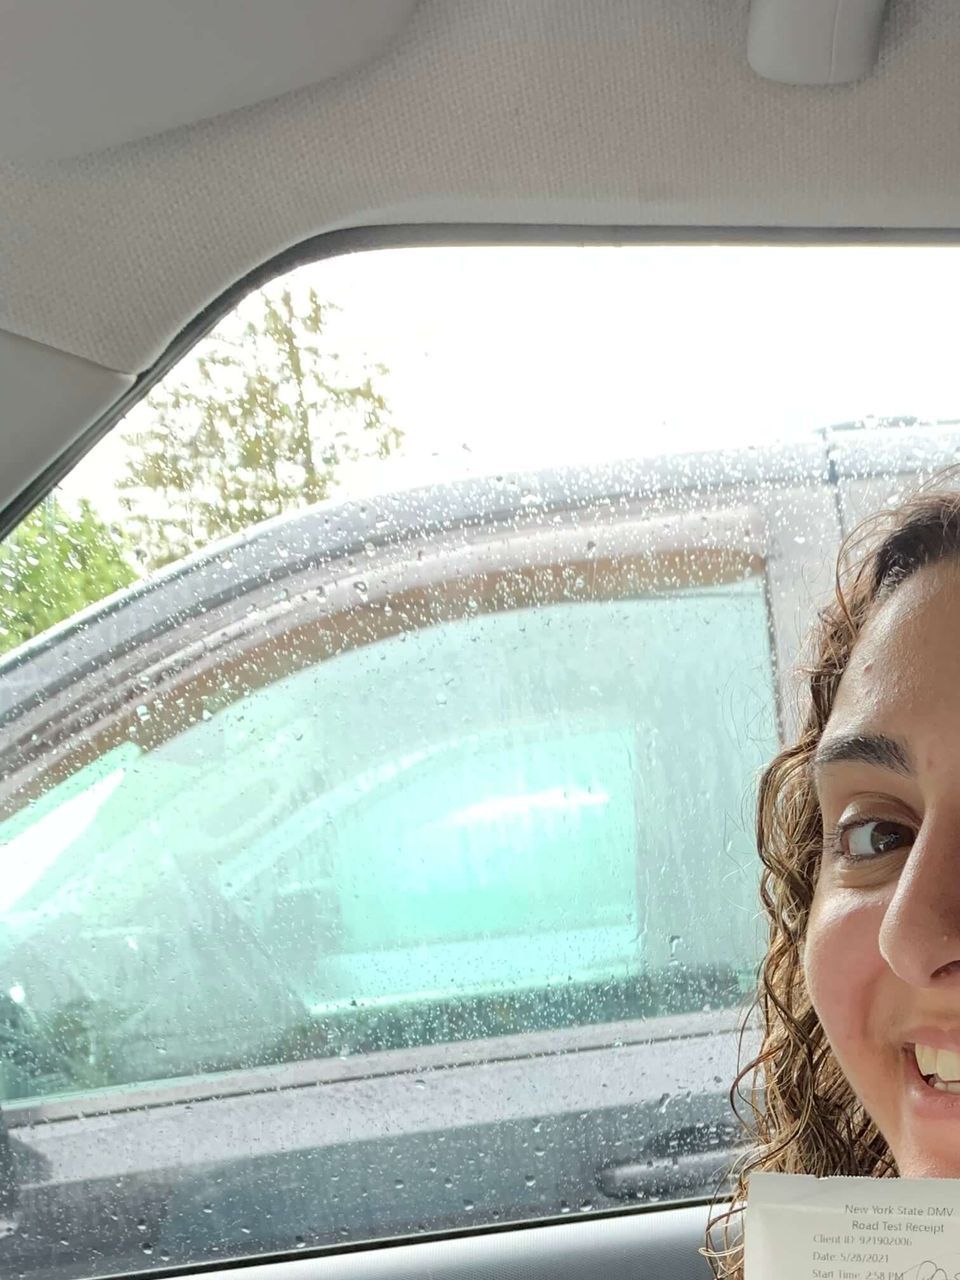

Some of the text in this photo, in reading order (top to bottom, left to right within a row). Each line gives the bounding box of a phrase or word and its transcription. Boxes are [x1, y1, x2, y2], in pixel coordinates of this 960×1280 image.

[845, 1204, 954, 1217] New York State DMV
[852, 1220, 944, 1234] Road Test Receipt
[813, 1234, 841, 1244] Client
[840, 1252, 889, 1263] 5/28/2021
[812, 1269, 834, 1279] Start
[865, 1271, 885, 1280] 2:58
